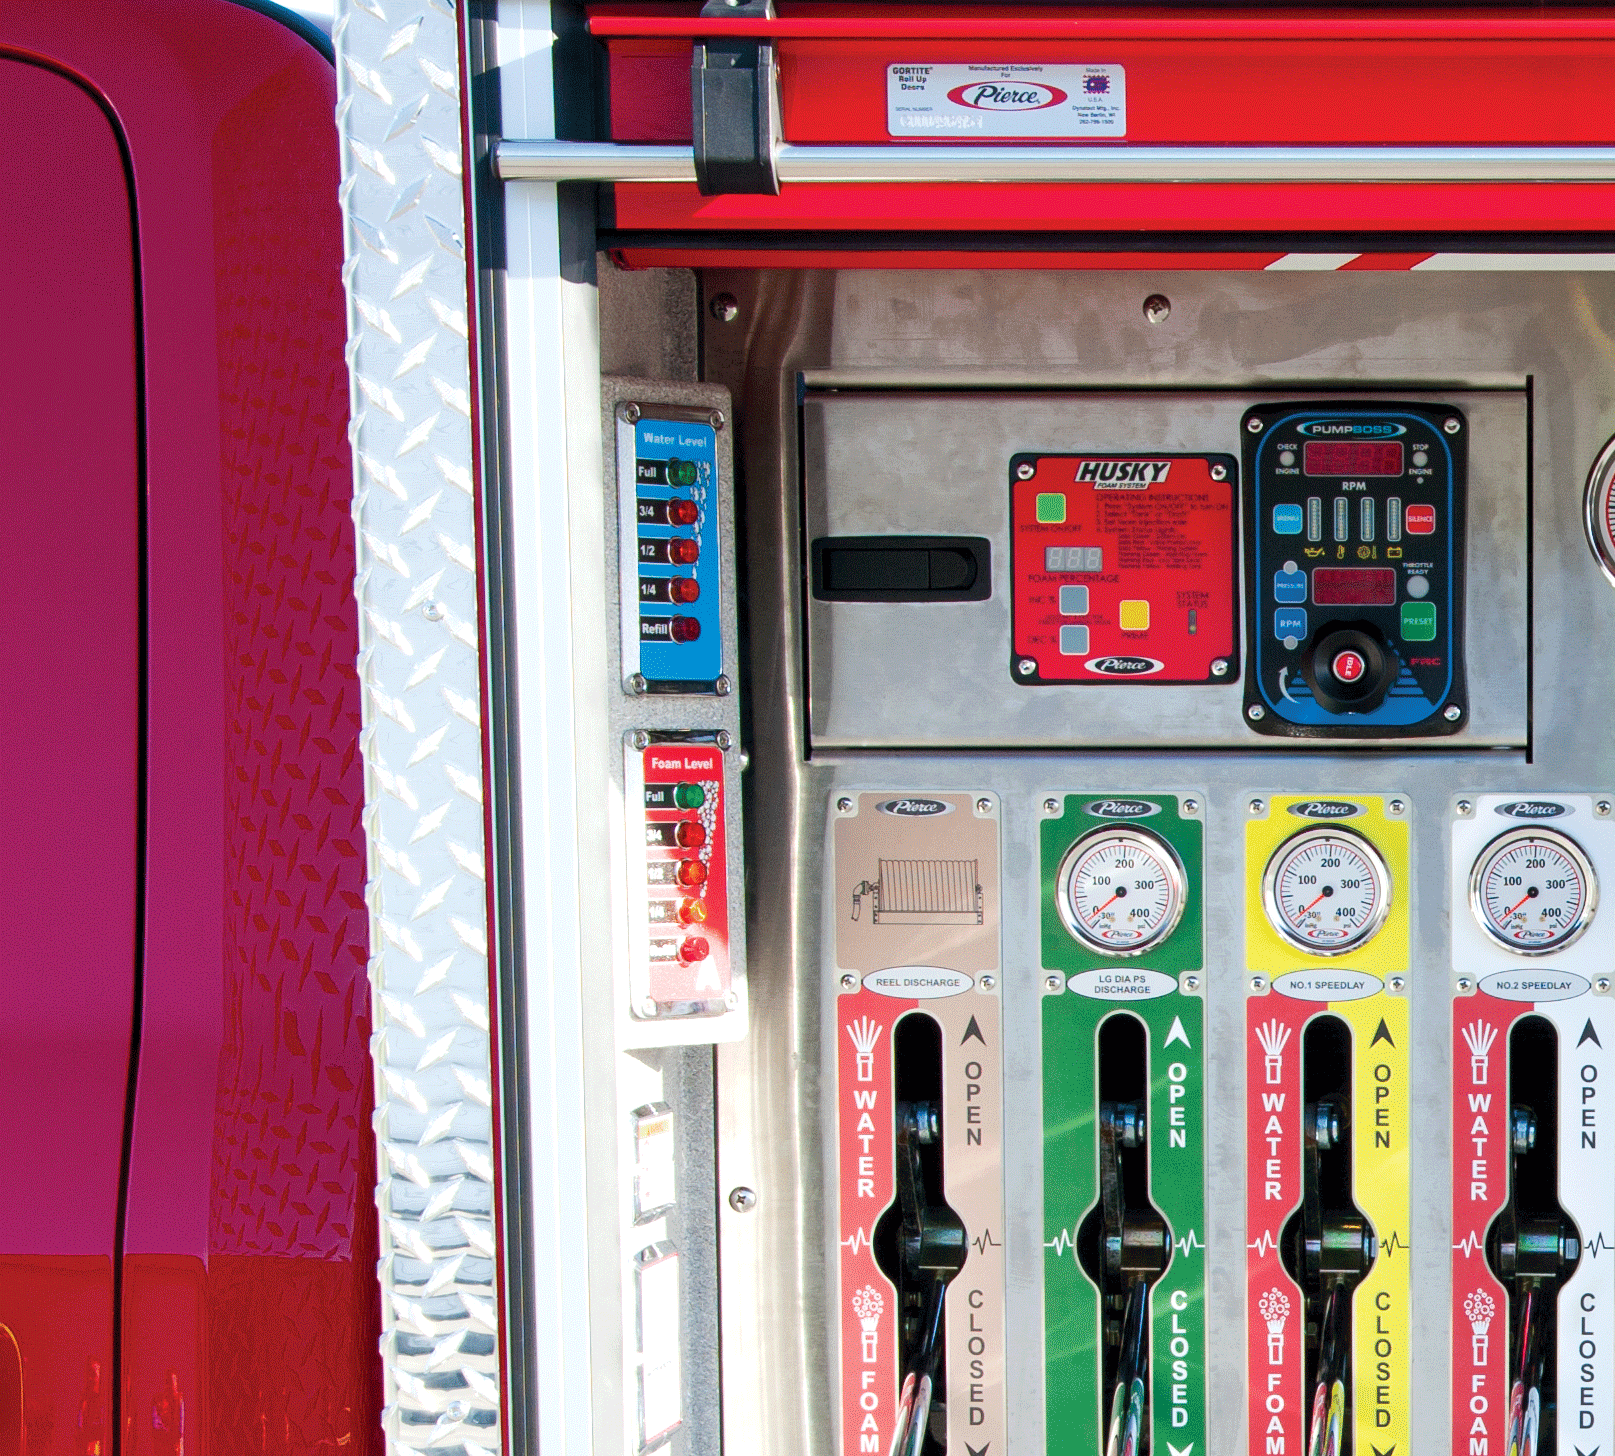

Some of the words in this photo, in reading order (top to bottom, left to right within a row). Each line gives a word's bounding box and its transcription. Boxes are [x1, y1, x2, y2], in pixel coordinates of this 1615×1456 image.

[974, 85, 1037, 105] Pierce
[644, 433, 674, 445] Water
[678, 435, 707, 447] Level
[638, 467, 656, 478] Full
[1079, 463, 1168, 481] HUSKY
[1342, 482, 1366, 490] RPM
[639, 505, 654, 517] 3/4
[640, 545, 655, 556] 1/2
[641, 584, 656, 595] 1/4
[642, 624, 667, 635] Refill
[1101, 658, 1145, 670] Pierce
[1345, 657, 1354, 676] IDLE
[652, 758, 681, 769] Foam
[684, 758, 713, 769] Level
[646, 792, 664, 801] Full
[895, 800, 937, 816] Pierce
[1099, 800, 1142, 817] Pierce
[1304, 801, 1349, 818] Pierce
[1511, 802, 1556, 818] Pierce
[1115, 860, 1134, 868] 200
[1093, 876, 1110, 885] 100
[1135, 881, 1154, 889] 300
[1130, 909, 1149, 917] 400
[876, 978, 899, 987] REEL
[903, 978, 960, 987] DISCHARGE
[1099, 975, 1112, 983] LG
[1115, 975, 1131, 983] DIA
[1133, 975, 1145, 983] PS
[1094, 985, 1150, 994] DISCHARGE
[965, 1061, 983, 1146] OPEN
[1169, 1063, 1186, 1148] OPEN
[1374, 1065, 1391, 1148] OPEN
[1580, 1065, 1598, 1149] OPEN
[853, 1090, 876, 1198] WATER
[1262, 1093, 1284, 1200] WATER
[1468, 1094, 1491, 1201] WATER
[968, 1290, 986, 1426] CLOSED
[1170, 1291, 1188, 1428] CLOSED
[1375, 1293, 1391, 1428] CLOSED
[1579, 1294, 1595, 1429] CLOSED
[861, 1371, 880, 1452] FOAM
[1267, 1374, 1285, 1455] FOAM
[1469, 1375, 1488, 1456] FOAM
